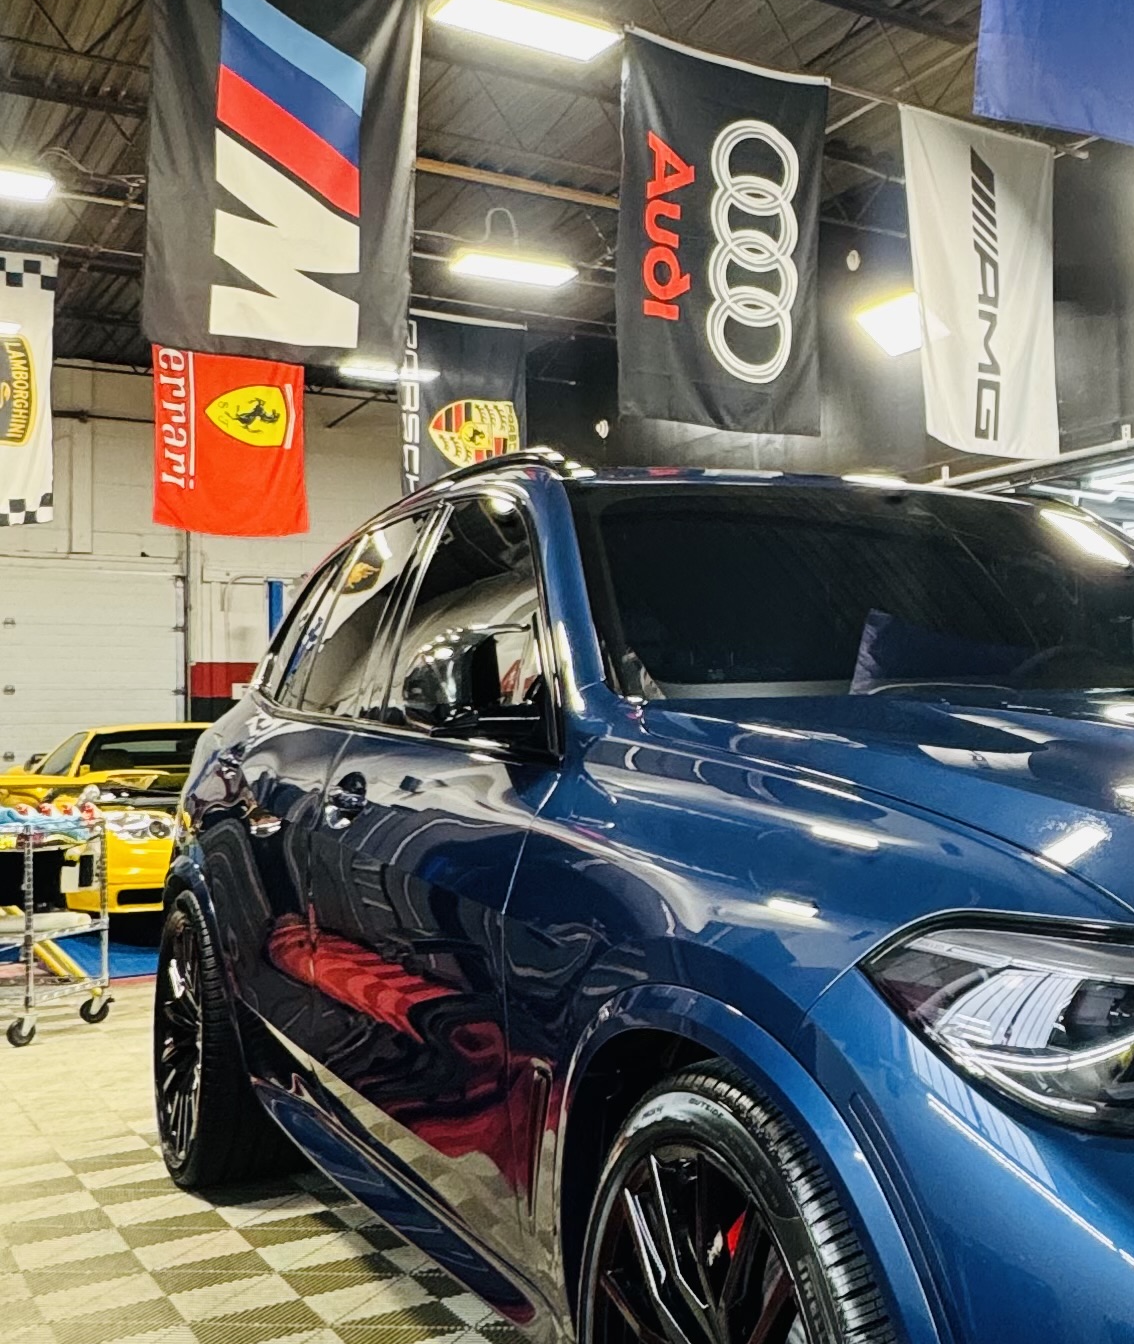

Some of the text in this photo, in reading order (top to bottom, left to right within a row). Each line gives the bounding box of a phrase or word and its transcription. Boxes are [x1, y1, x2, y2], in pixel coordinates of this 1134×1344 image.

[642, 130, 696, 321] Audi
[4, 340, 29, 439] LAMBORGHINI
[158, 347, 195, 490] errari
